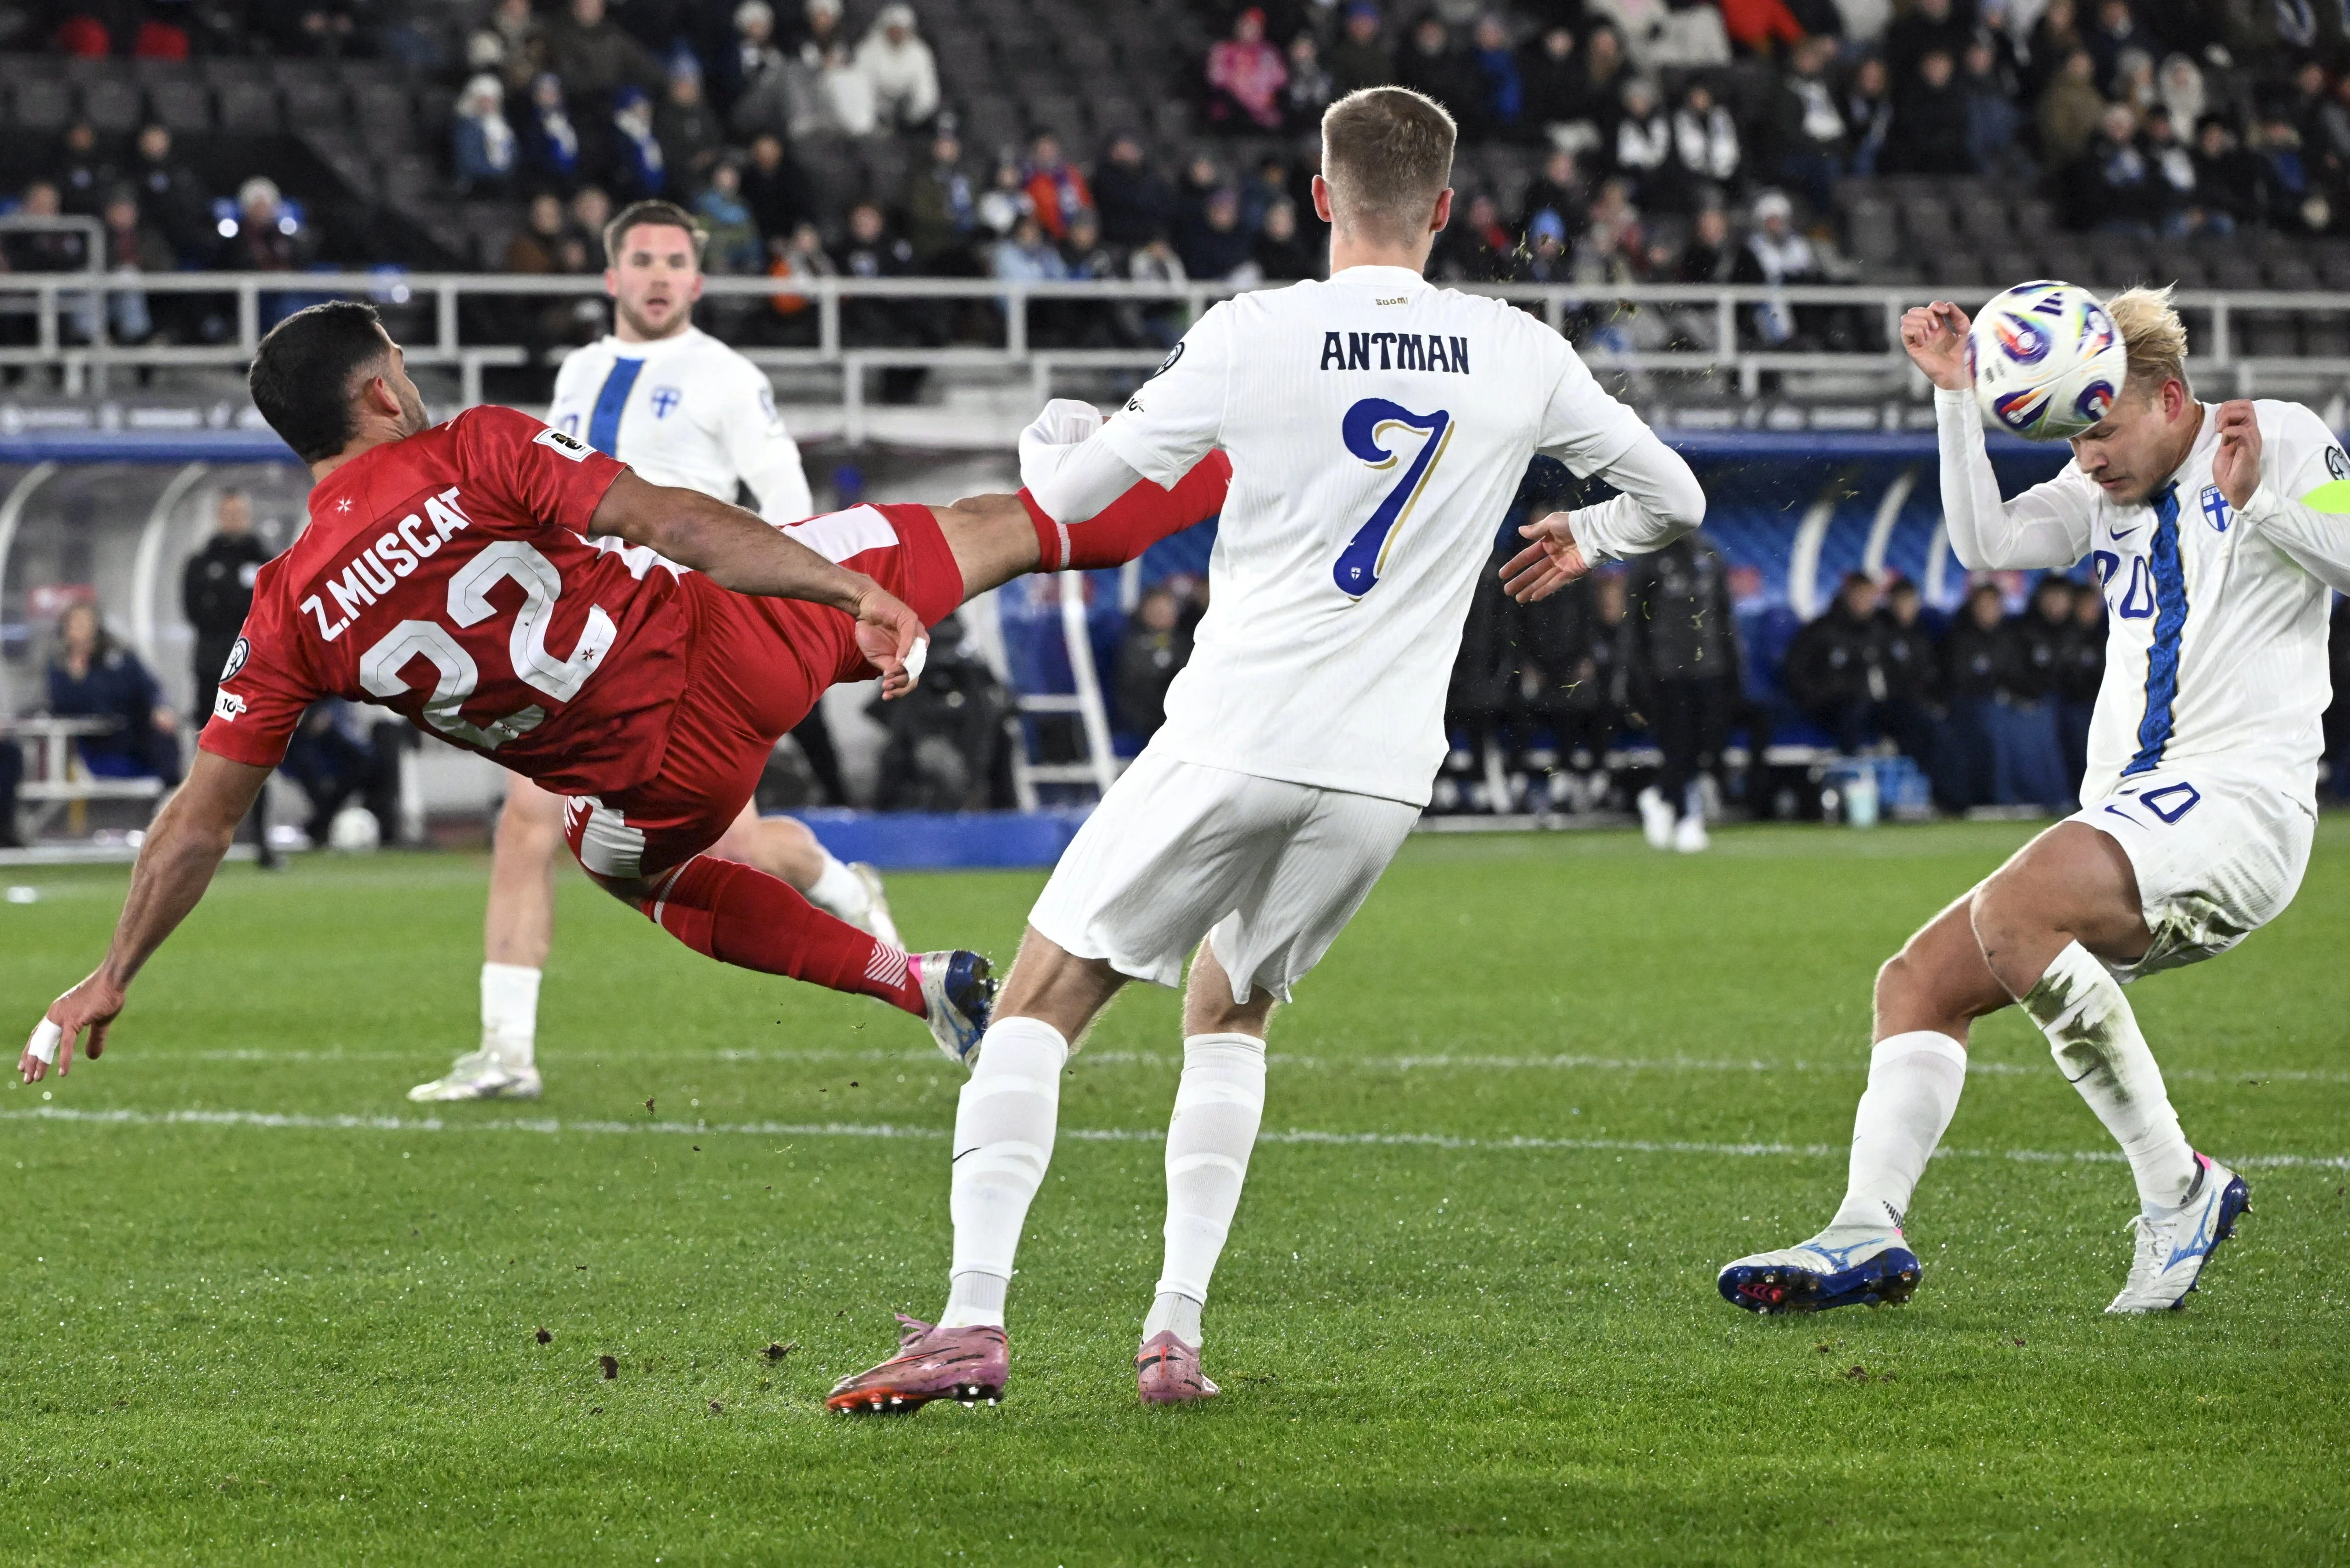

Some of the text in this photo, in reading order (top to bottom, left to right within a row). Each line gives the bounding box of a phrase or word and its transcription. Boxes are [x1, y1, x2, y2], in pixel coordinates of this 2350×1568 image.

[1320, 331, 1470, 375] ANTMAN
[1333, 398, 1455, 602] 7
[2204, 488, 2217, 496] SUO
[360, 541, 617, 751] 22
